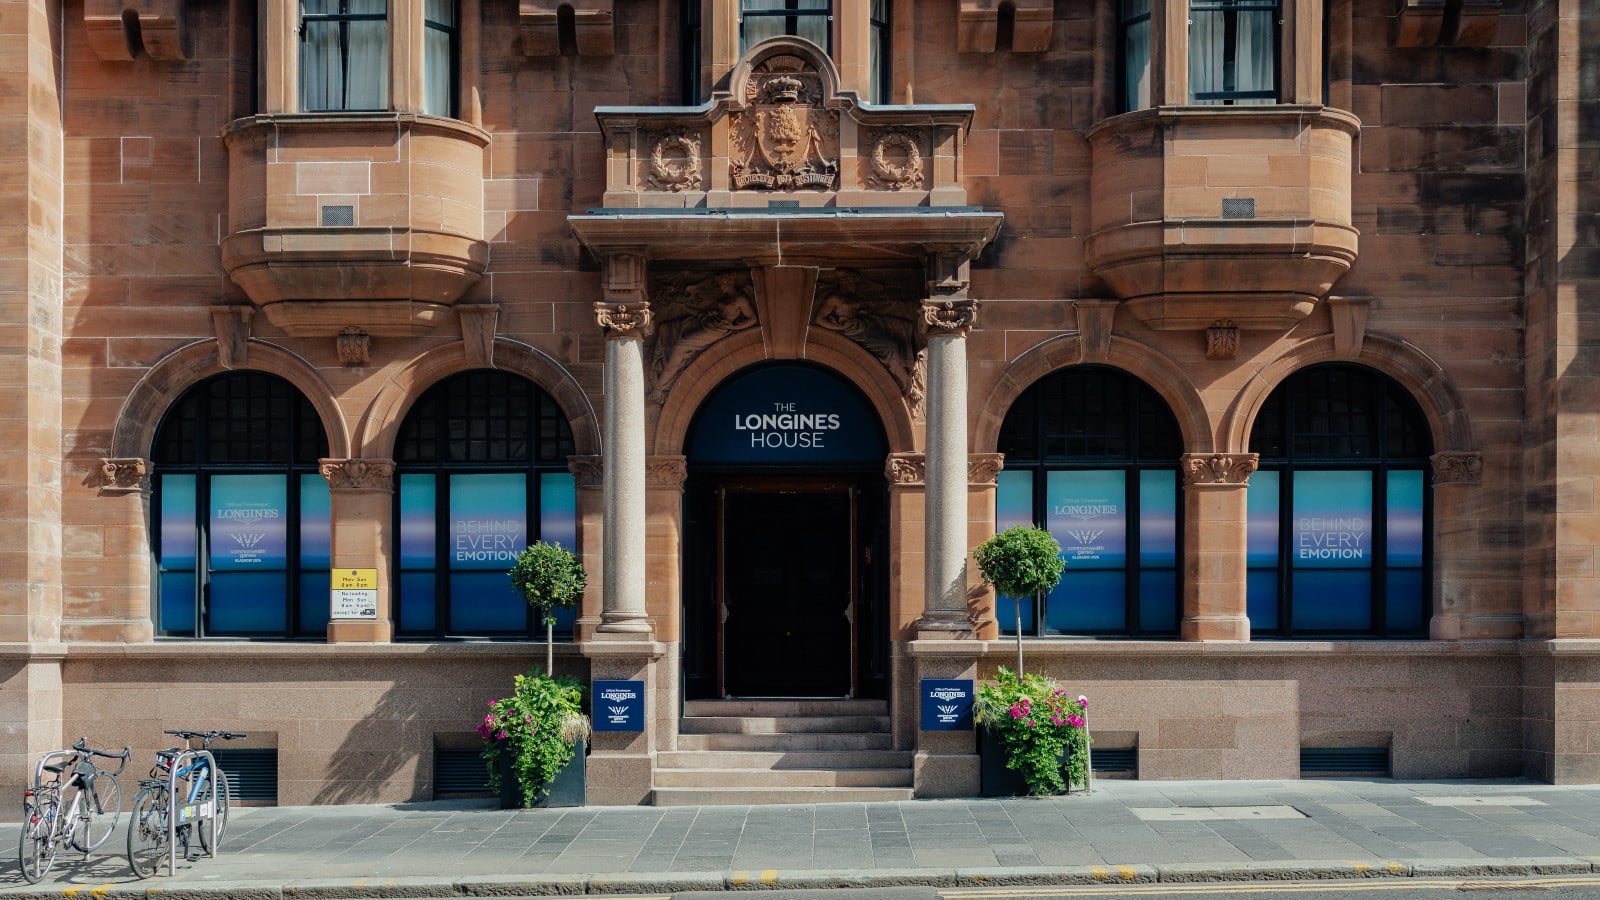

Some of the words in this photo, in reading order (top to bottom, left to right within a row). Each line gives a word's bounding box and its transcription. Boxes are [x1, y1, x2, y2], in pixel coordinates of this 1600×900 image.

[774, 402, 796, 412] THE
[735, 414, 840, 430] LONGINES
[751, 432, 825, 448] HOUSE
[217, 509, 279, 519] LONGINES
[1055, 505, 1117, 515] LONGINES
[456, 520, 519, 533] BEHIND
[1300, 518, 1363, 531] BEHIND
[456, 534, 519, 549] EVERY
[1300, 532, 1364, 547] EVERY
[456, 551, 518, 561] EMOTION
[1300, 548, 1363, 559] EMOTION
